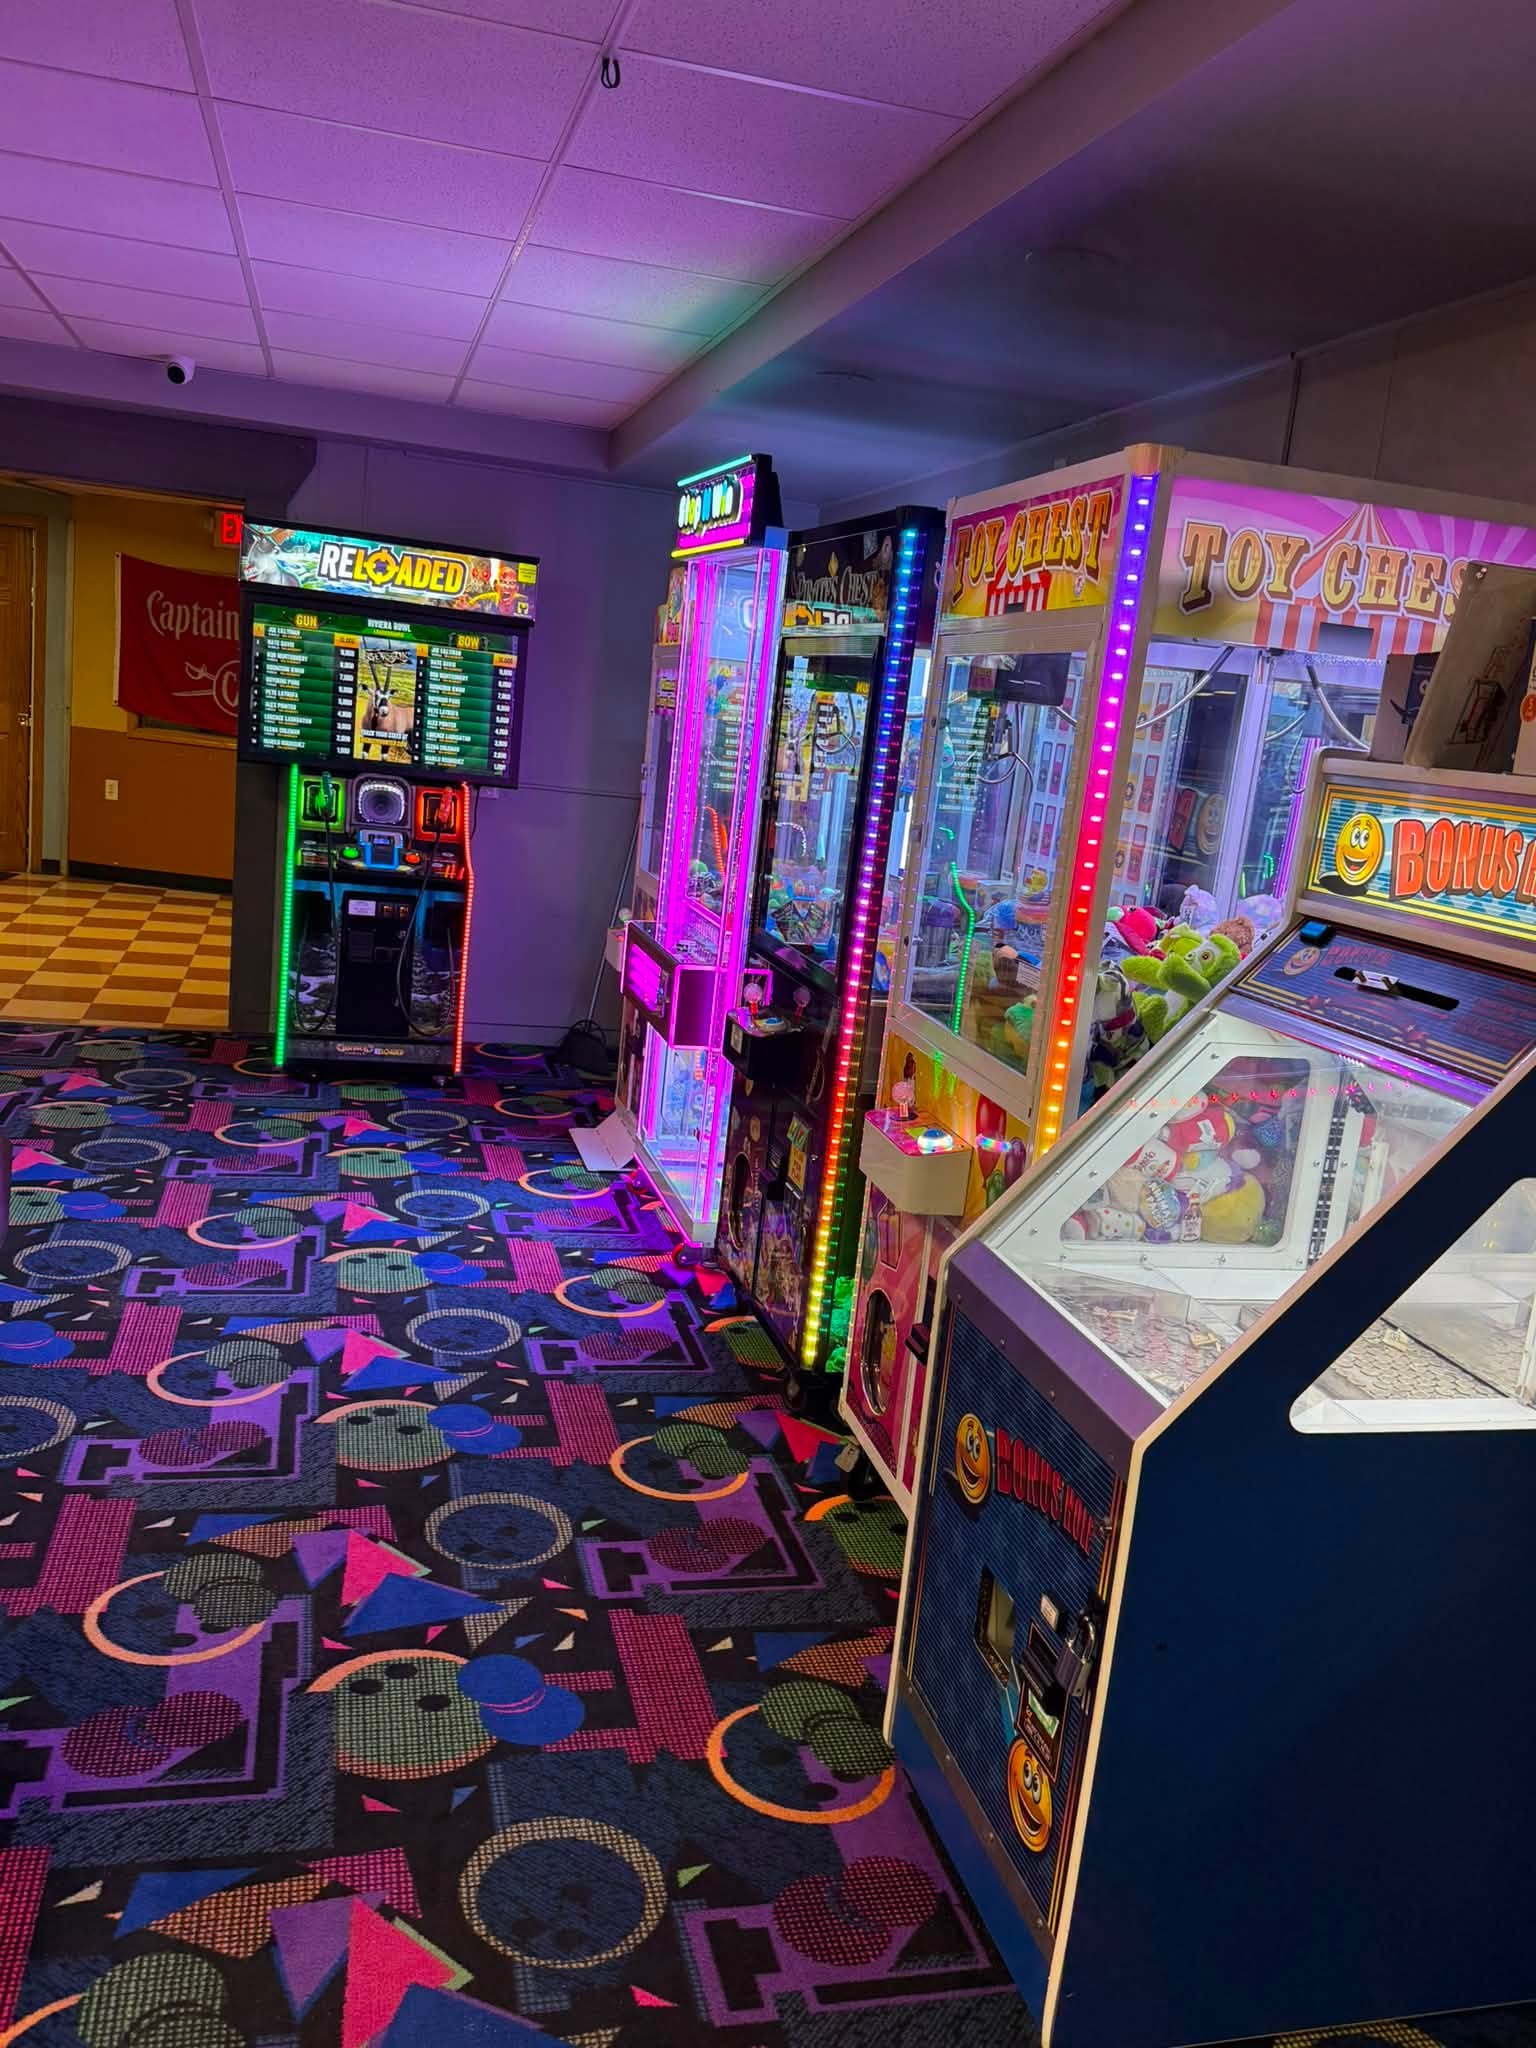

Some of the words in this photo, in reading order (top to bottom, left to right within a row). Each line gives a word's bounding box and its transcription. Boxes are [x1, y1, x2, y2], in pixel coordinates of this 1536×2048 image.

[320, 542, 464, 594] RELOADED
[953, 519, 1005, 603] TOY
[1007, 489, 1113, 582] CHEST
[1183, 520, 1312, 612] TOY
[147, 590, 240, 640] Captain
[295, 614, 318, 627] GUN
[457, 635, 480, 649] BOW
[1391, 818, 1524, 900] BONUS
[996, 1427, 1064, 1521] BONUS
[1063, 1483, 1095, 1557] HOLE
